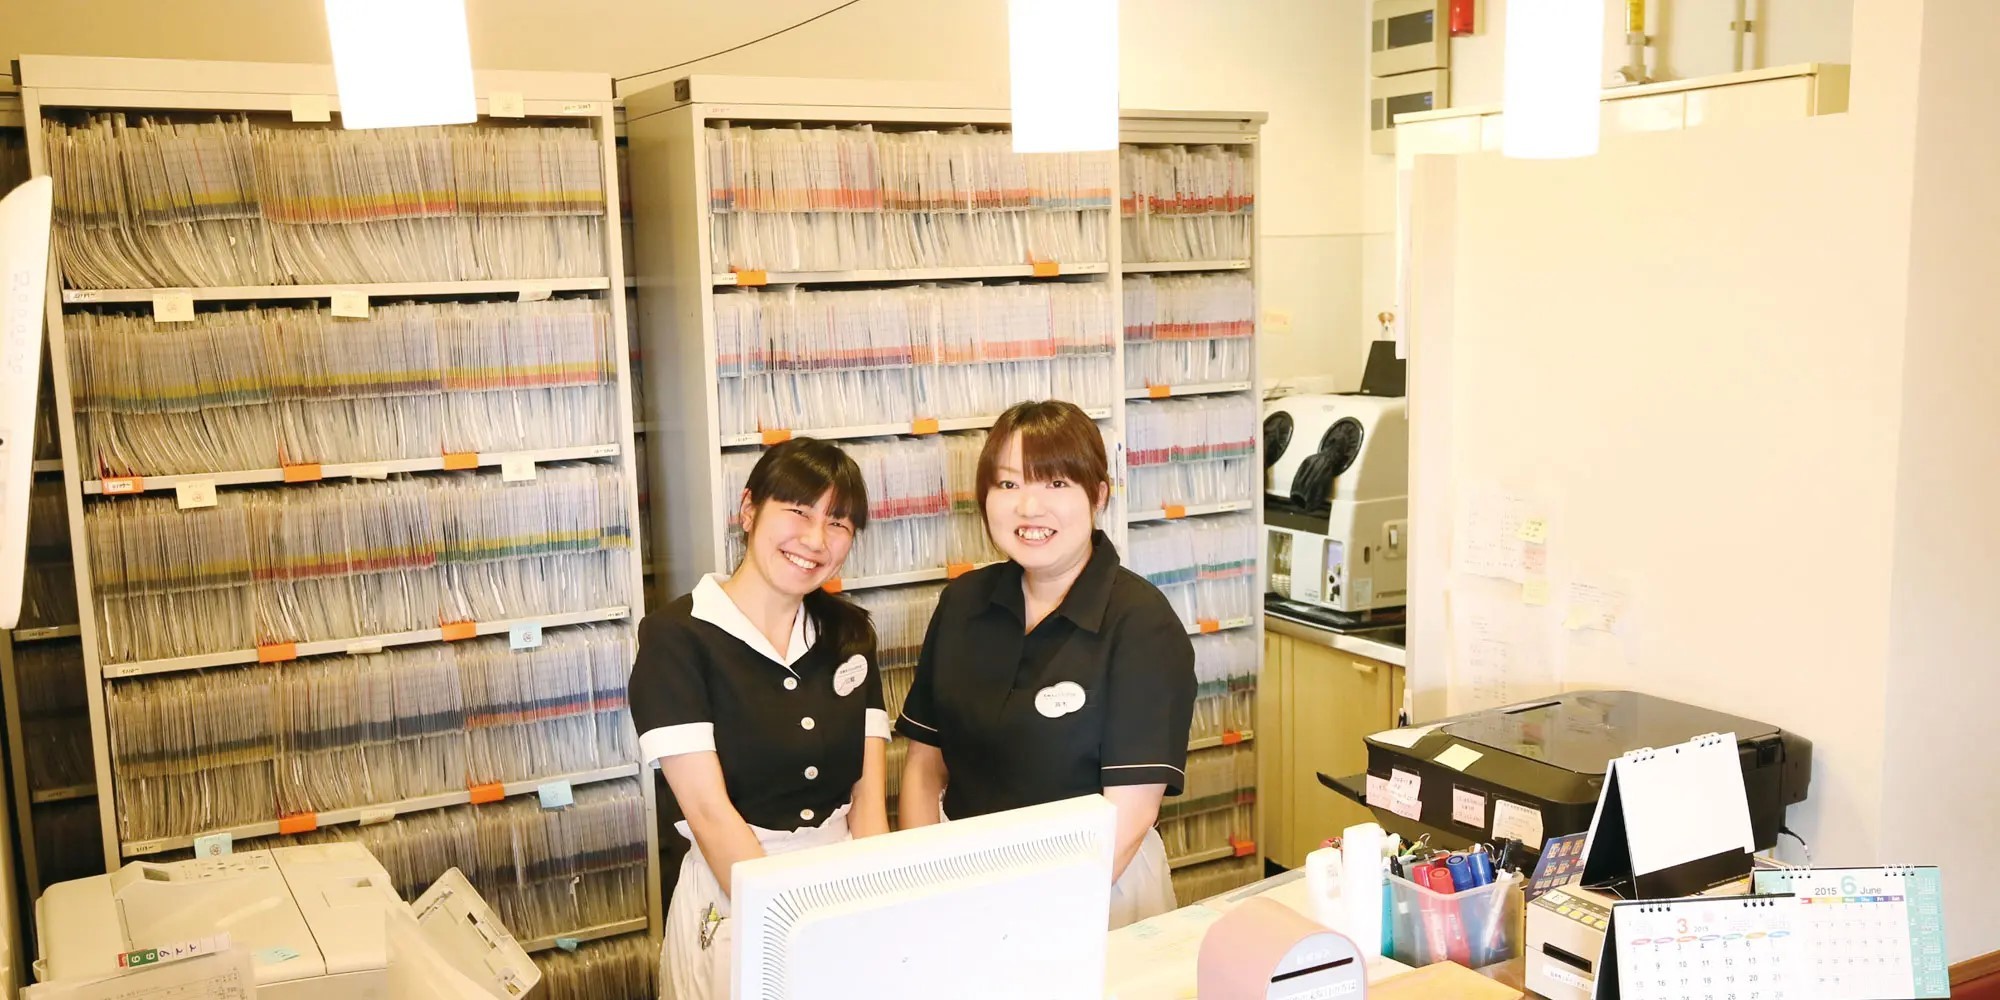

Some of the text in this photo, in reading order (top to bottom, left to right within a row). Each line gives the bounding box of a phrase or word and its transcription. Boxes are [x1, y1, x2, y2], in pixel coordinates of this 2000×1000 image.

[1814, 875, 1882, 896] 2015 6 June
[1677, 918, 1688, 934] 3
[1654, 944, 1659, 952] 2
[1725, 958, 1733, 966] 12
[1658, 979, 1666, 987] 16
[1749, 974, 1758, 982] 20
